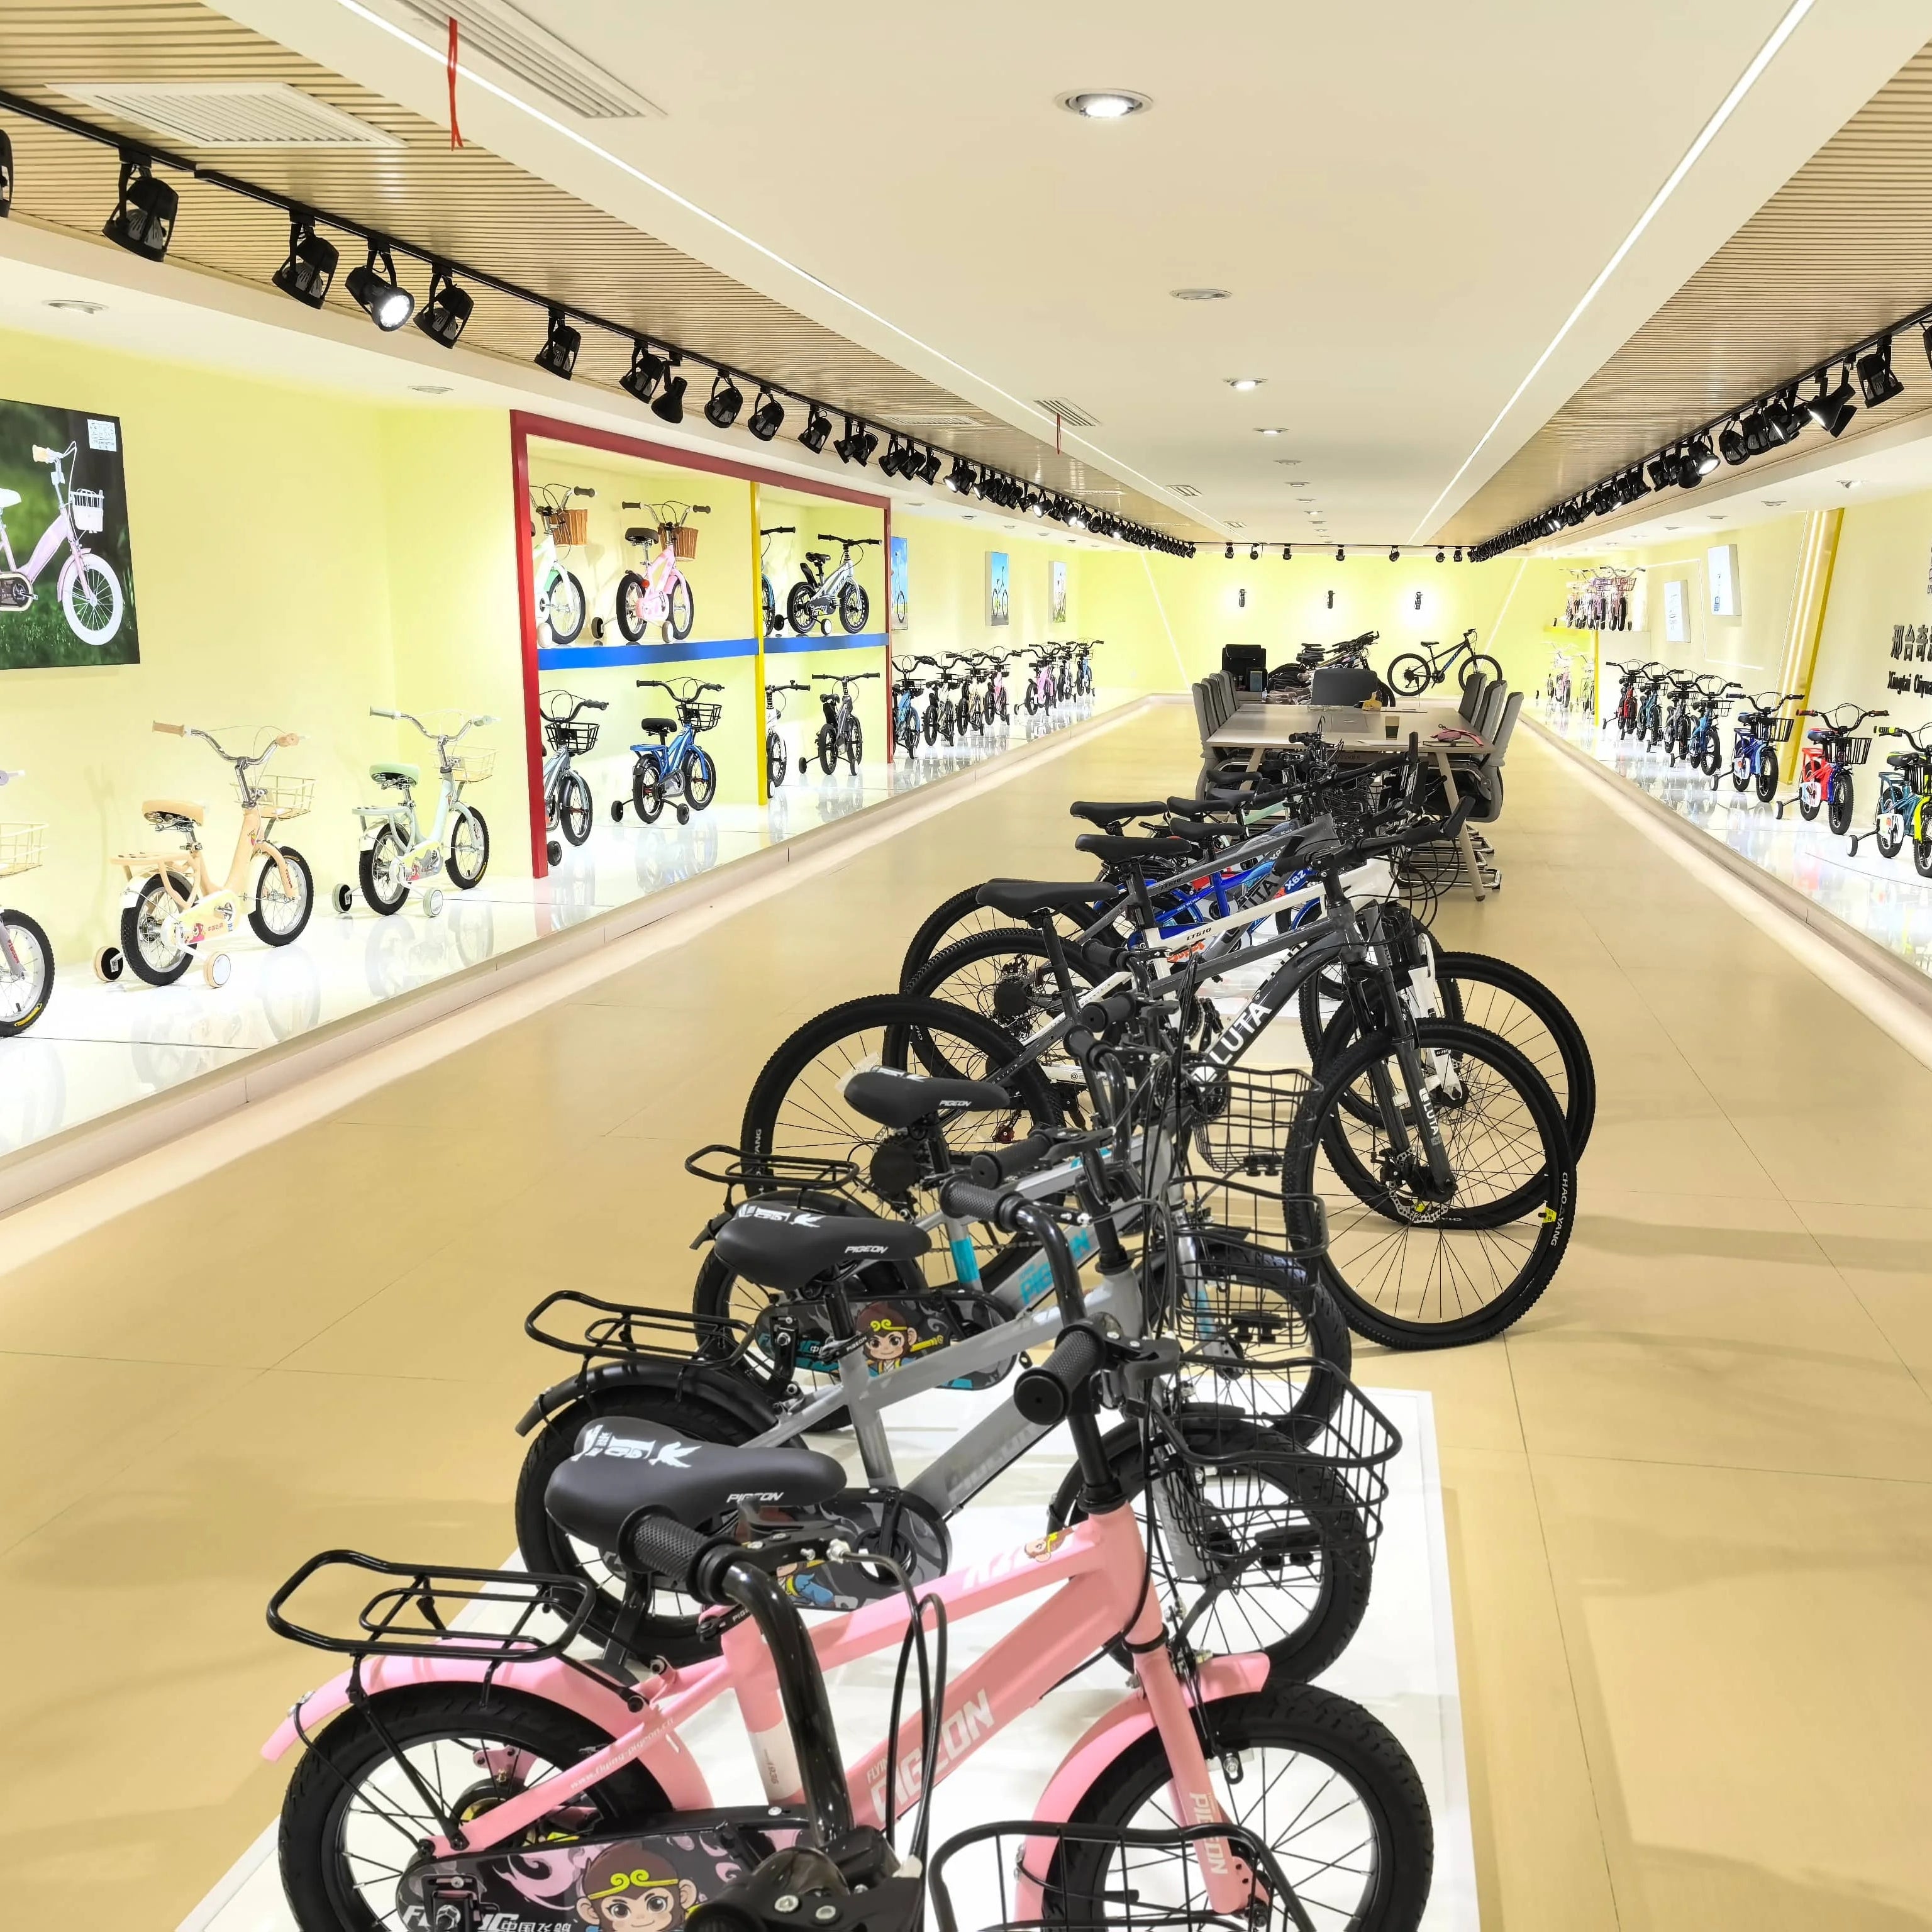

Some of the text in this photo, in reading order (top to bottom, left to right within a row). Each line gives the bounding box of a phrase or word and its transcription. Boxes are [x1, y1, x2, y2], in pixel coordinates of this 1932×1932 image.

[1209, 1002, 1272, 1064] LUTA
[1423, 1102, 1439, 1136] LUTA
[1560, 1172, 1569, 1205] CHAO
[1550, 1216, 1564, 1247] YANG
[844, 1245, 889, 1254] PIGEON
